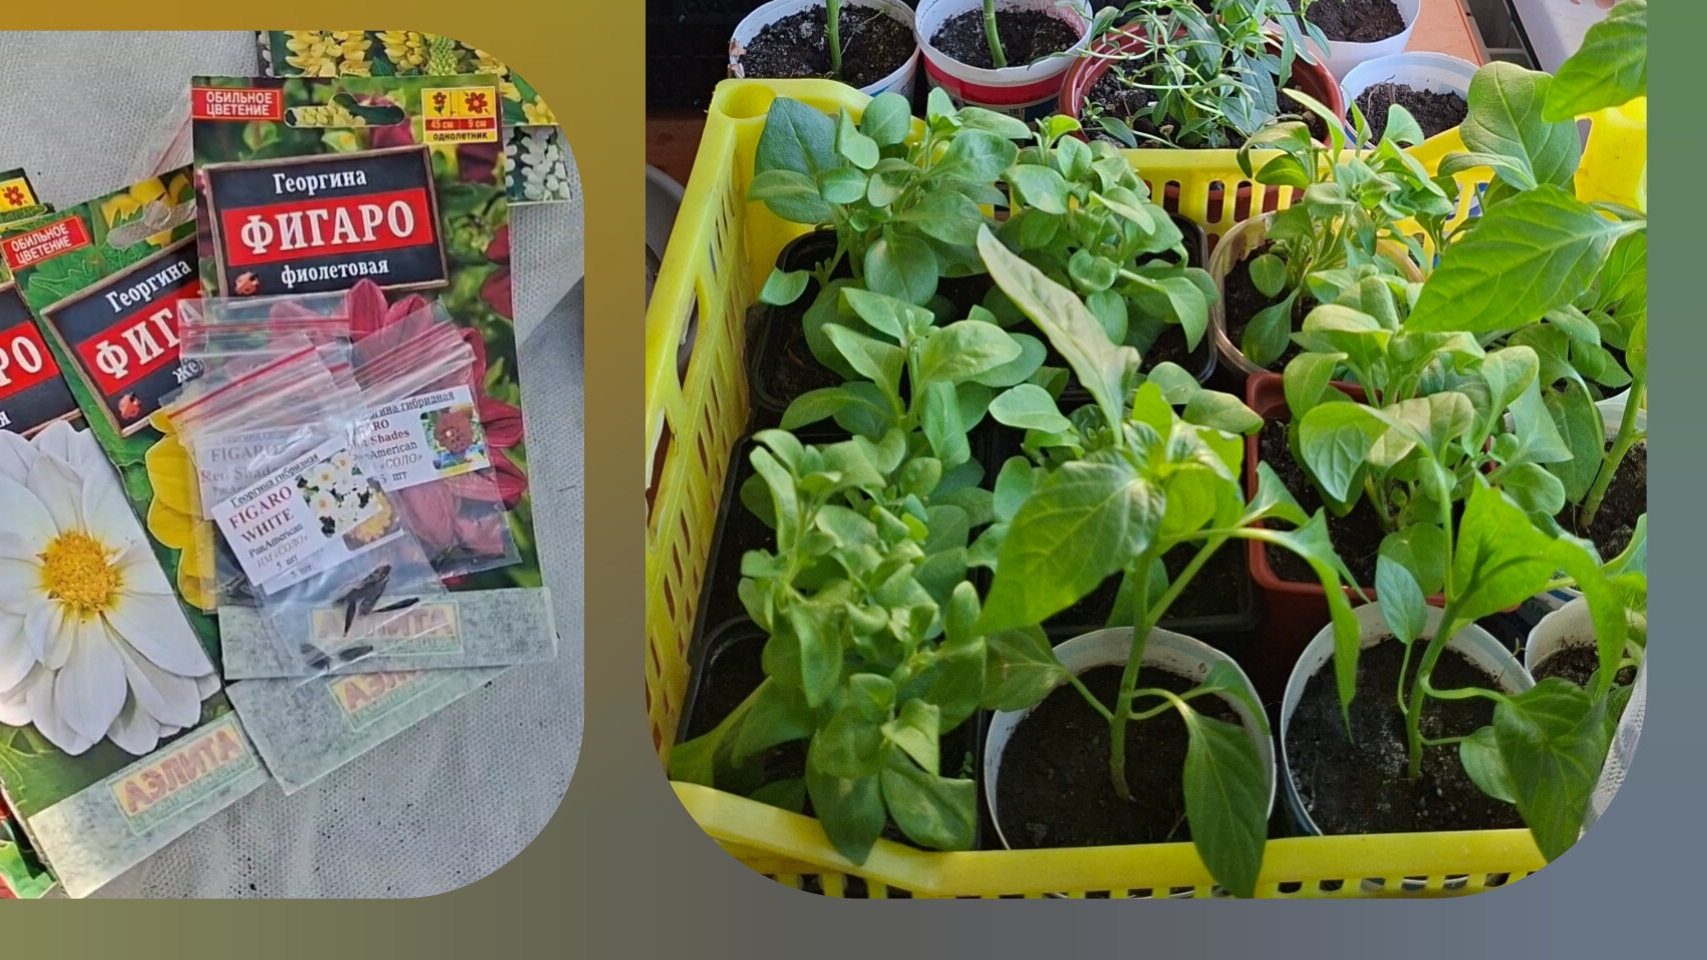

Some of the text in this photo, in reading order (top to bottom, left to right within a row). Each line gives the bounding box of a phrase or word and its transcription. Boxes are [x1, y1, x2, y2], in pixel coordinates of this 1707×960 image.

[206, 91, 273, 104] ОБИЛЬНОЕ
[206, 103, 270, 117] ЦВЕТЕНИЕ
[431, 121, 441, 129] 45
[433, 131, 488, 141] однолетник
[272, 169, 368, 195] Георгина
[11, 223, 69, 252] ОБИЛЬНОЕ
[240, 200, 415, 255] ФИГАРО
[16, 236, 72, 265] ЦВЕТЕНИЕ
[105, 260, 192, 313] Георгина
[281, 259, 390, 288] фиолетовая
[400, 392, 455, 411] гибридная
[370, 429, 411, 446] Shades
[230, 478, 274, 508] Георгина
[275, 453, 319, 483] гибридная
[392, 471, 408, 481] шт
[228, 486, 293, 530] FIGARO
[241, 508, 294, 544] WHITE
[248, 523, 304, 558] PanAmerican
[286, 554, 299, 566] шт
[124, 730, 239, 814] АЭЛИТА
